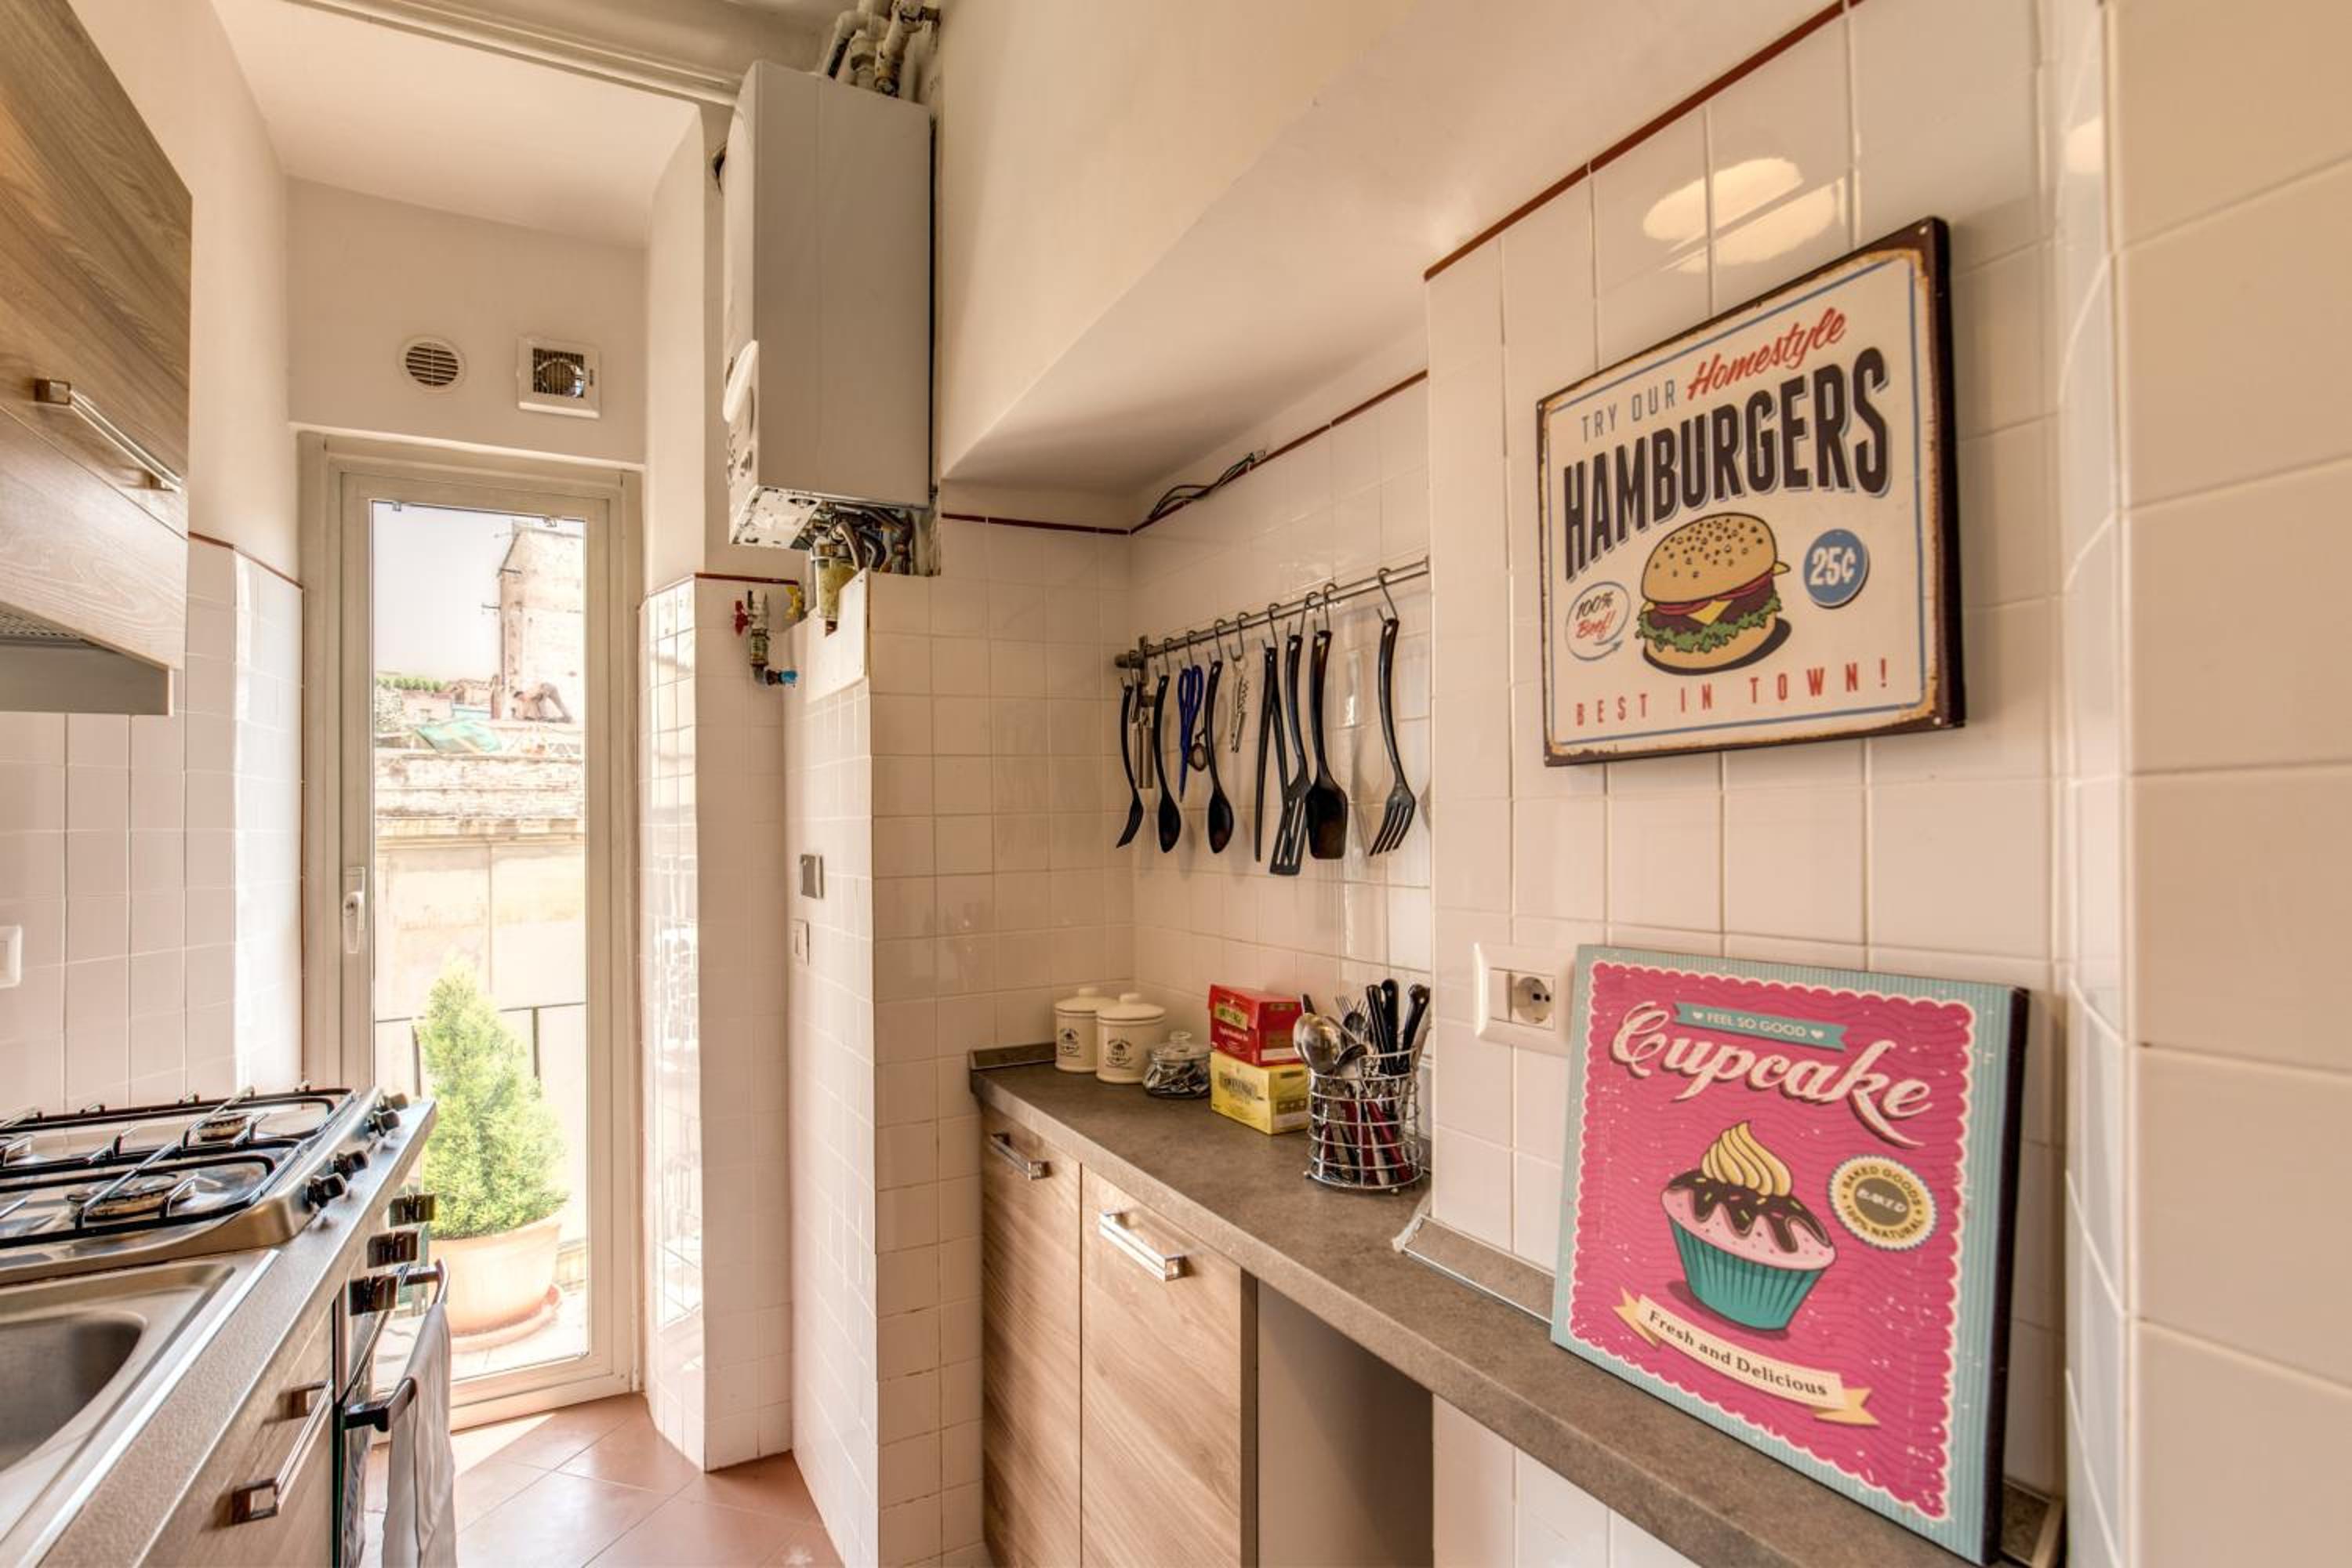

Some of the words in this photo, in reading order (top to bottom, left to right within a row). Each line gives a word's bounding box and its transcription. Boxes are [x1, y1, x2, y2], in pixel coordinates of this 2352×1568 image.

[1581, 403, 1617, 443] TRY
[1632, 379, 1675, 422] OUR
[1687, 307, 1847, 401] Homestyle
[1564, 347, 1890, 582] HAMBURGERS
[1809, 547, 1857, 586] 25¢
[1576, 590, 1614, 621] 100%
[1576, 609, 1617, 640] Beef!
[1576, 693, 1648, 727] BEST
[1680, 683, 1713, 713] IN
[1749, 658, 1888, 704] TOWN!
[1705, 1012, 1732, 1026] FEEL
[1737, 1017, 1756, 1029] SO
[1759, 1020, 1807, 1037] GOOD
[1611, 1000, 1934, 1149] Cupcake
[1882, 1167, 1922, 1206] GOODS
[1871, 1215, 1925, 1240] NATURAL
[1649, 1309, 1695, 1346] Fresh
[1699, 1342, 1731, 1365] and
[1737, 1356, 1828, 1396] Delicious
